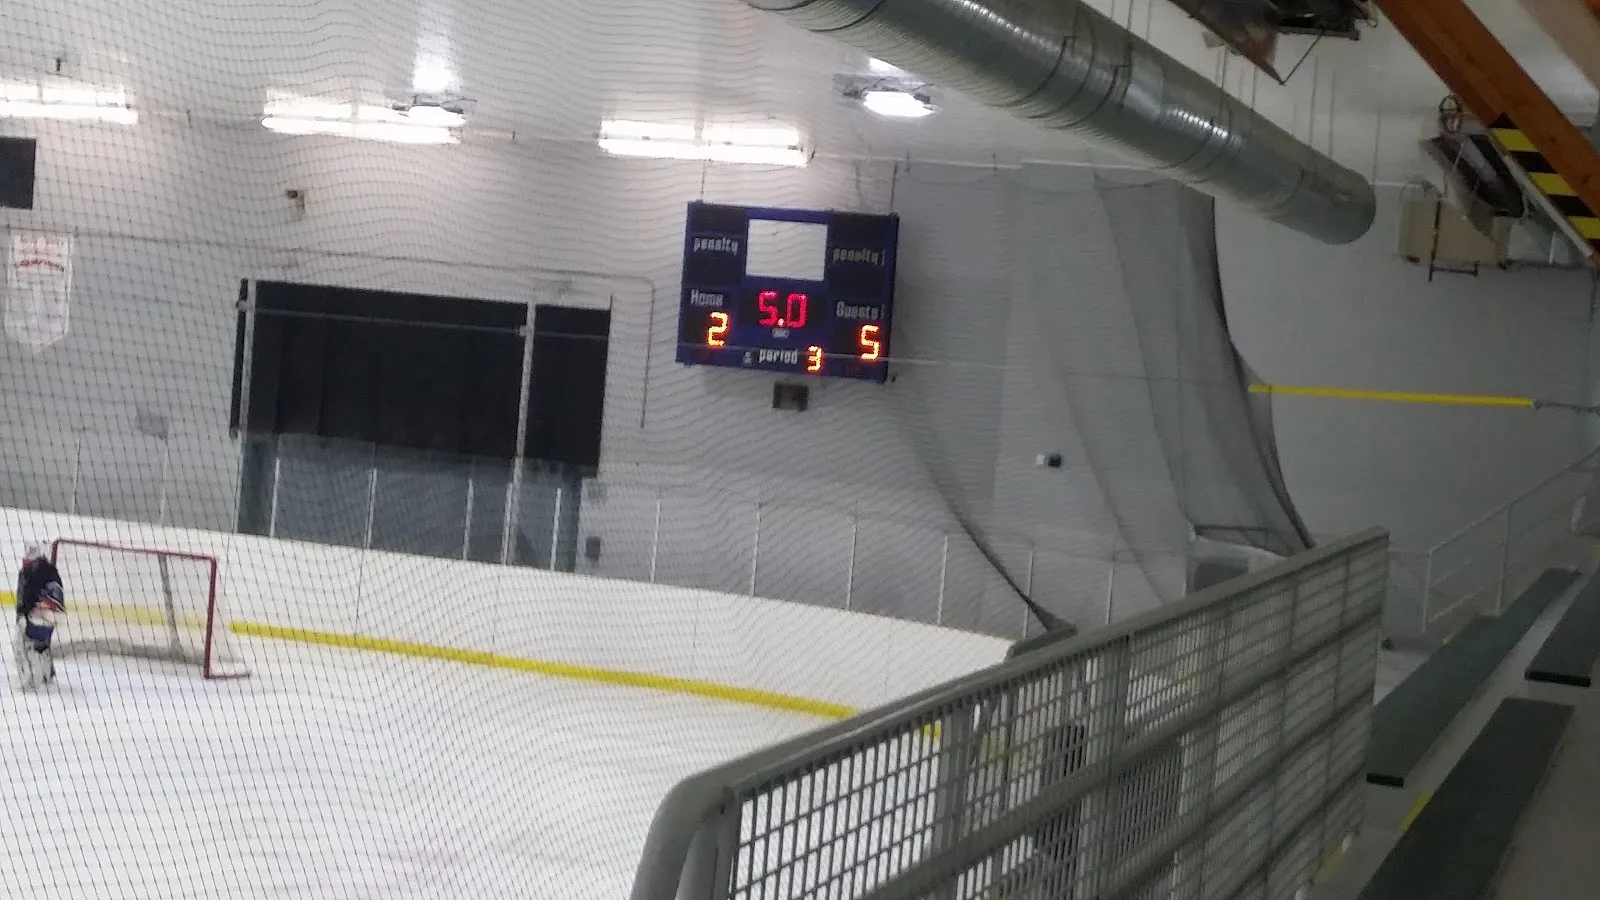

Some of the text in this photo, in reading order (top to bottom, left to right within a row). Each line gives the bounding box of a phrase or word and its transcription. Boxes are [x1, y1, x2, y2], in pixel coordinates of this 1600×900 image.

[693, 236, 739, 256] penalty
[832, 247, 879, 266] penalty
[689, 288, 724, 307] Home
[758, 290, 808, 328] 5.0
[836, 300, 879, 320] Guests
[706, 311, 728, 346] 2
[860, 324, 880, 361] 5
[758, 345, 822, 372] period 3
